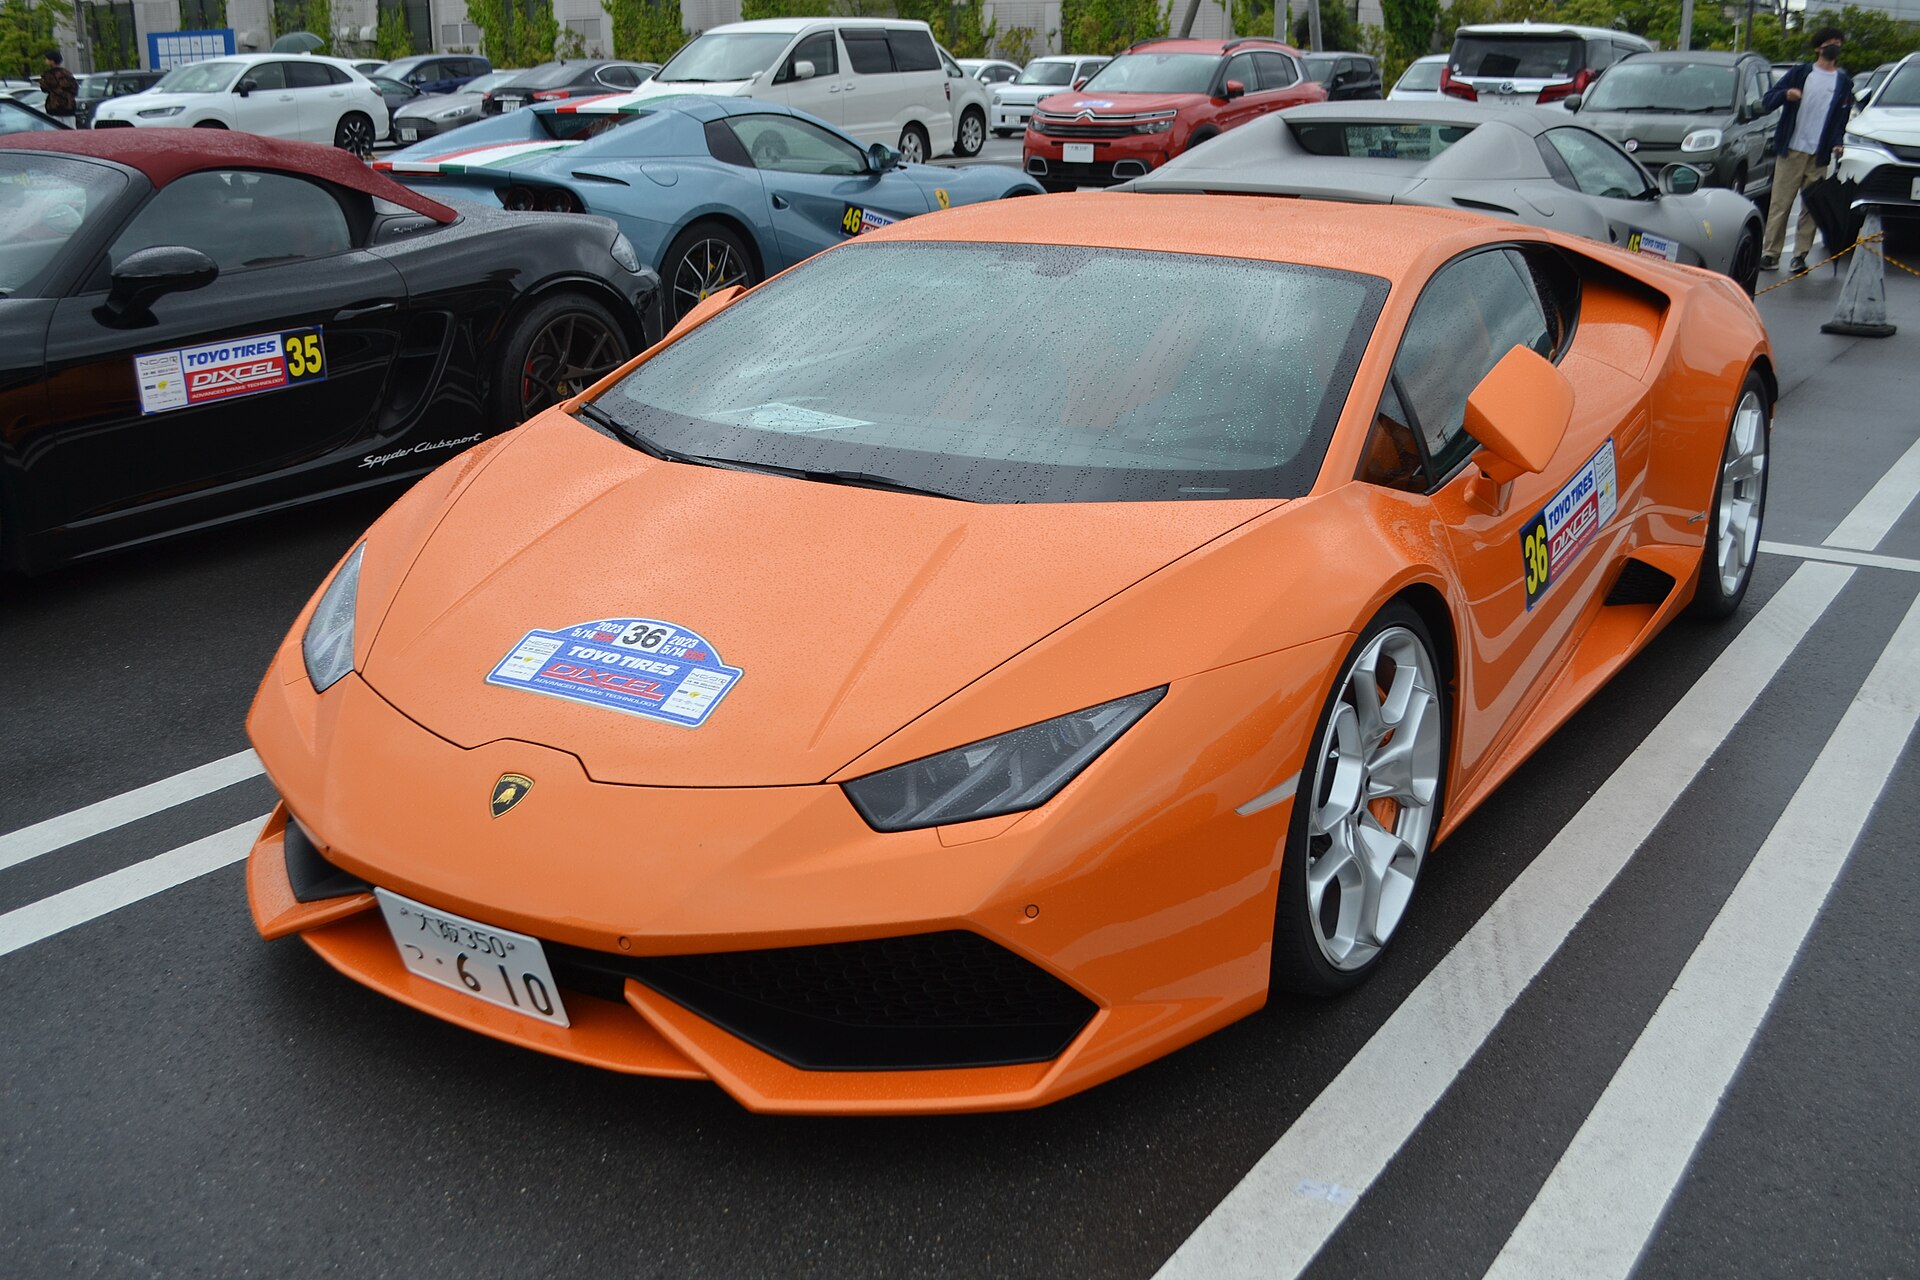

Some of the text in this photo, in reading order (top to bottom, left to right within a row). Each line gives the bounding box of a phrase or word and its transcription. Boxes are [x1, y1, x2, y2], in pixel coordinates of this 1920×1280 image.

[843, 207, 861, 233] 46
[865, 212, 882, 224] TOYO
[187, 348, 230, 367] TOYO
[232, 341, 276, 359] TIRES
[286, 334, 322, 377] 35
[191, 361, 282, 391] DIXCEL
[192, 388, 225, 399] ADVANCED
[226, 384, 246, 393] BRAKE
[247, 377, 285, 389] TECHNOLOGY
[358, 433, 482, 469] Spyder Clubsport
[1548, 493, 1571, 530] TOYO
[1571, 470, 1593, 506] TIRES
[1551, 501, 1597, 567] DIXCEL
[1525, 524, 1548, 595] 36
[594, 621, 625, 634] 2023
[622, 625, 667, 649] 36
[667, 635, 699, 649] 2023
[567, 645, 621, 664] TOYO
[618, 655, 680, 676] TIRES
[534, 678, 576, 690] ADVANCED
[576, 686, 604, 696] BRAKE
[605, 692, 658, 707] TECHNOLOGY
[540, 662, 665, 701] DIXCEL
